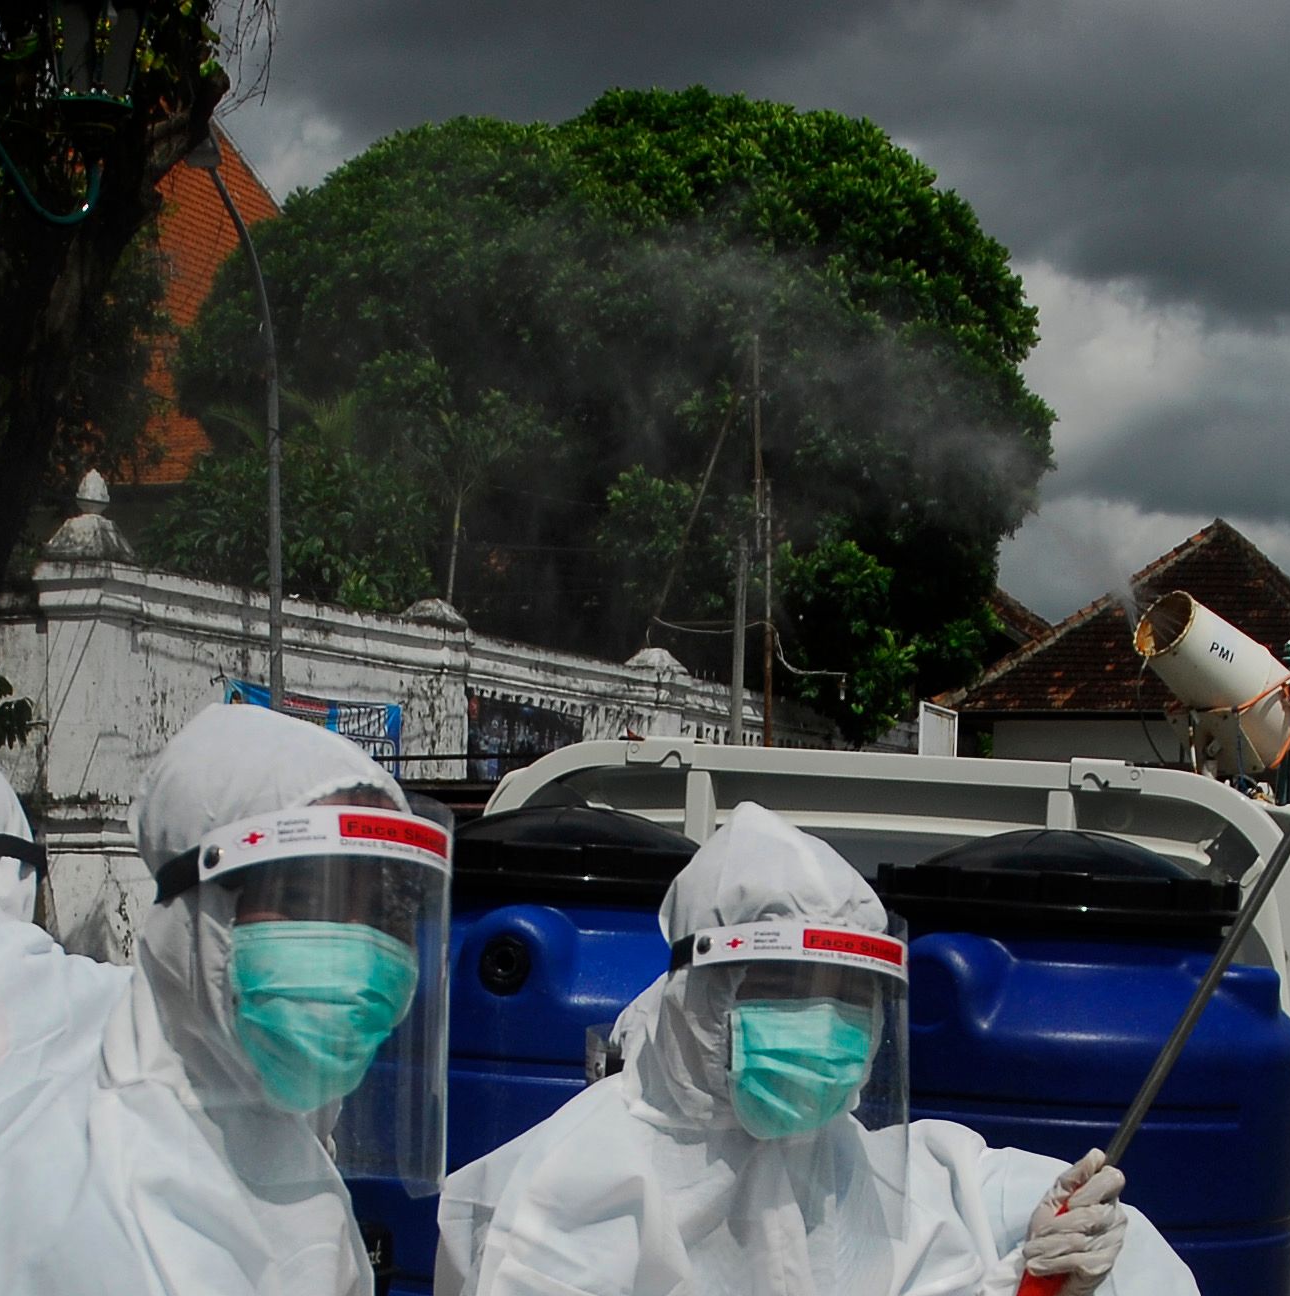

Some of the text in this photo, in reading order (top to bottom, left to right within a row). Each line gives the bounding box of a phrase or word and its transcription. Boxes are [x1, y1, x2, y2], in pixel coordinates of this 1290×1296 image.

[1209, 641, 1235, 664] PMI
[347, 820, 398, 838] Face
[810, 935, 855, 951] Face
